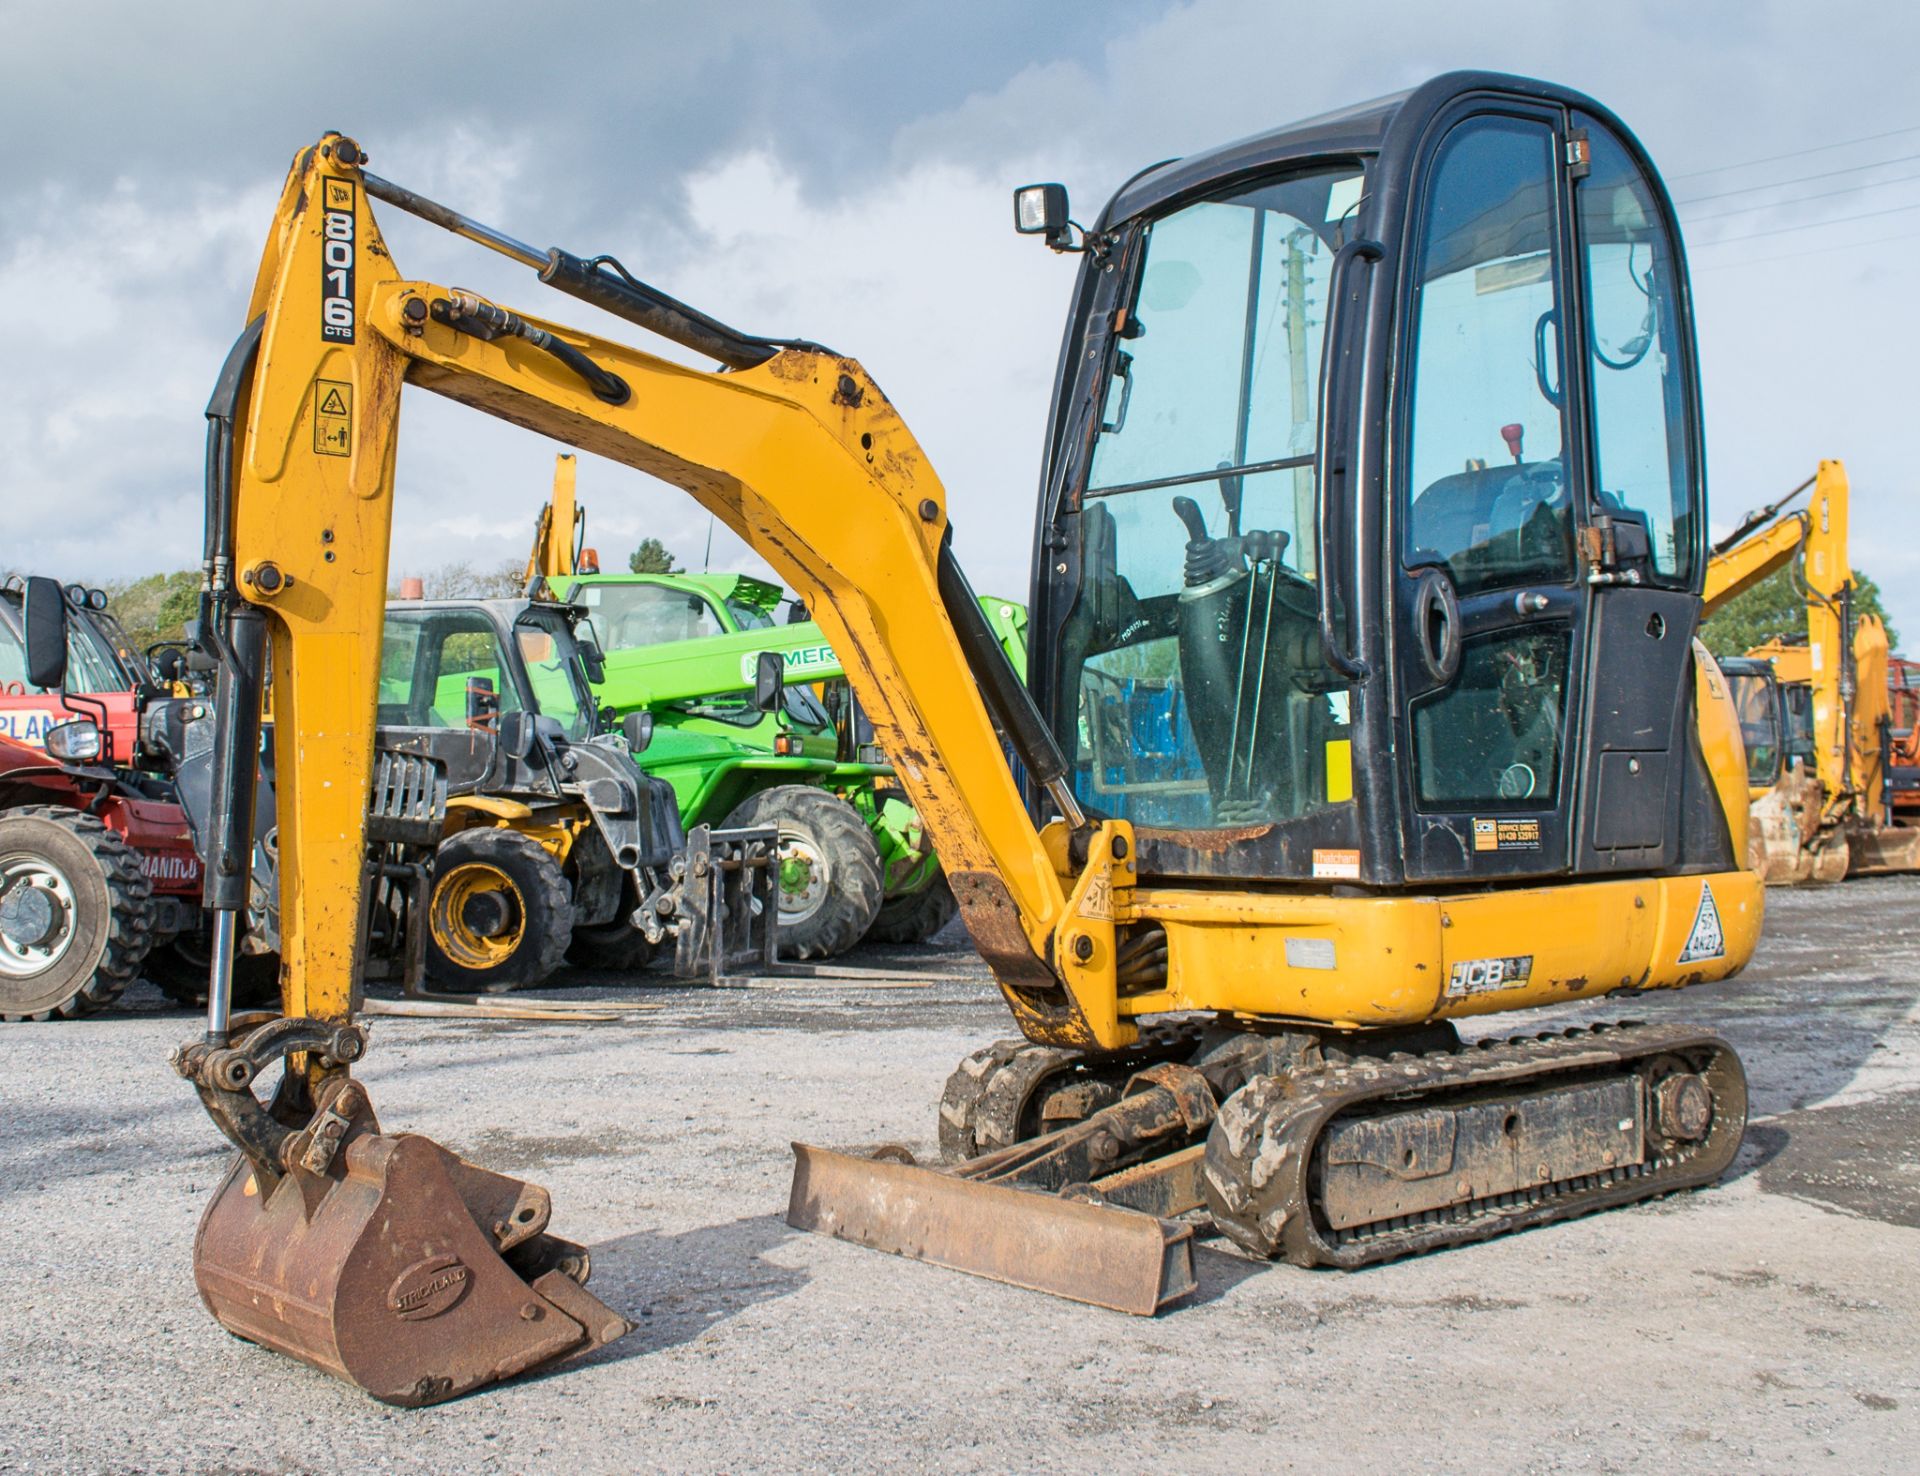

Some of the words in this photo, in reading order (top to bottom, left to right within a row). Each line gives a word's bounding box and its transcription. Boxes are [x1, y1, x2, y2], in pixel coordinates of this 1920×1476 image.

[324, 211, 353, 327] 8016
[324, 326, 352, 338] CTS
[781, 646, 836, 667] MER
[0, 715, 58, 740] PLAN
[1475, 822, 1494, 832] JCB
[1314, 851, 1358, 864] Thatcham
[1451, 959, 1505, 989] JCB
[396, 1269, 466, 1310] STRICKLAND
